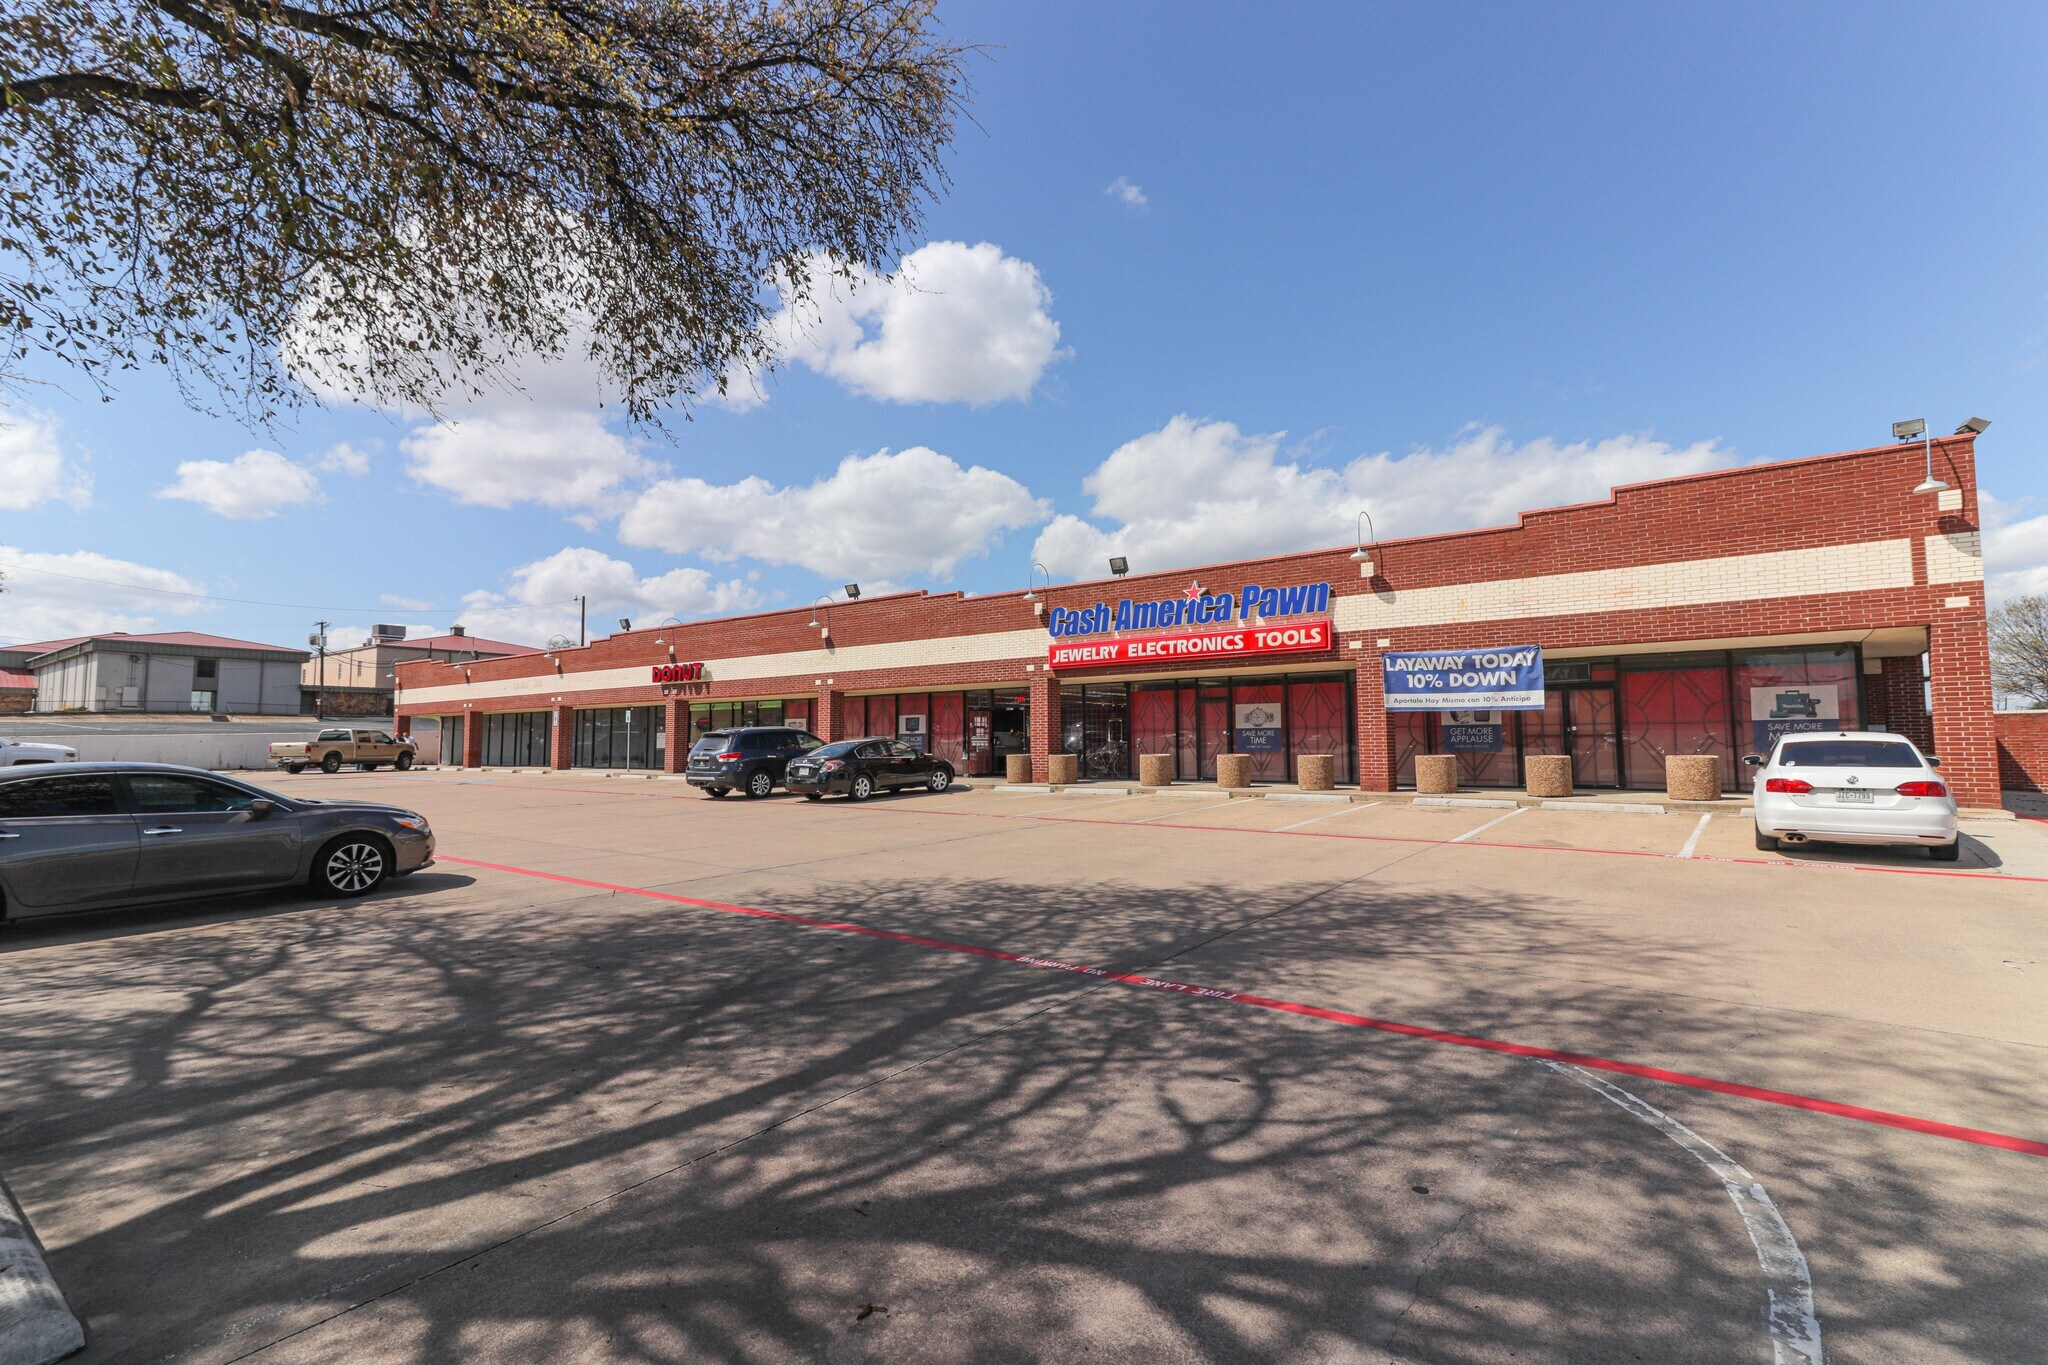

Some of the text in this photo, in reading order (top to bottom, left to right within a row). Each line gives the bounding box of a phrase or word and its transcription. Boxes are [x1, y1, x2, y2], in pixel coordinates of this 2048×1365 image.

[1049, 582, 1330, 638] Cash America Pawn
[1052, 628, 1322, 663] JEWELRY ELECTRONICS TOOLS
[1385, 651, 1536, 672] LAYAWAY TODAY
[1406, 671, 1517, 688] 10% DOWN
[1425, 697, 1440, 705] Hoy
[1442, 696, 1466, 704] Mismo
[1500, 695, 1531, 703] Anticipo
[1449, 726, 1493, 736] GET MORE
[1767, 722, 1823, 731] SAVE MORE
[1257, 729, 1275, 737] MORE
[1250, 736, 1267, 744] TIME
[1450, 735, 1493, 743] APPLAUSE
[1016, 956, 1238, 1000] FIRE LANE NO PARKING
